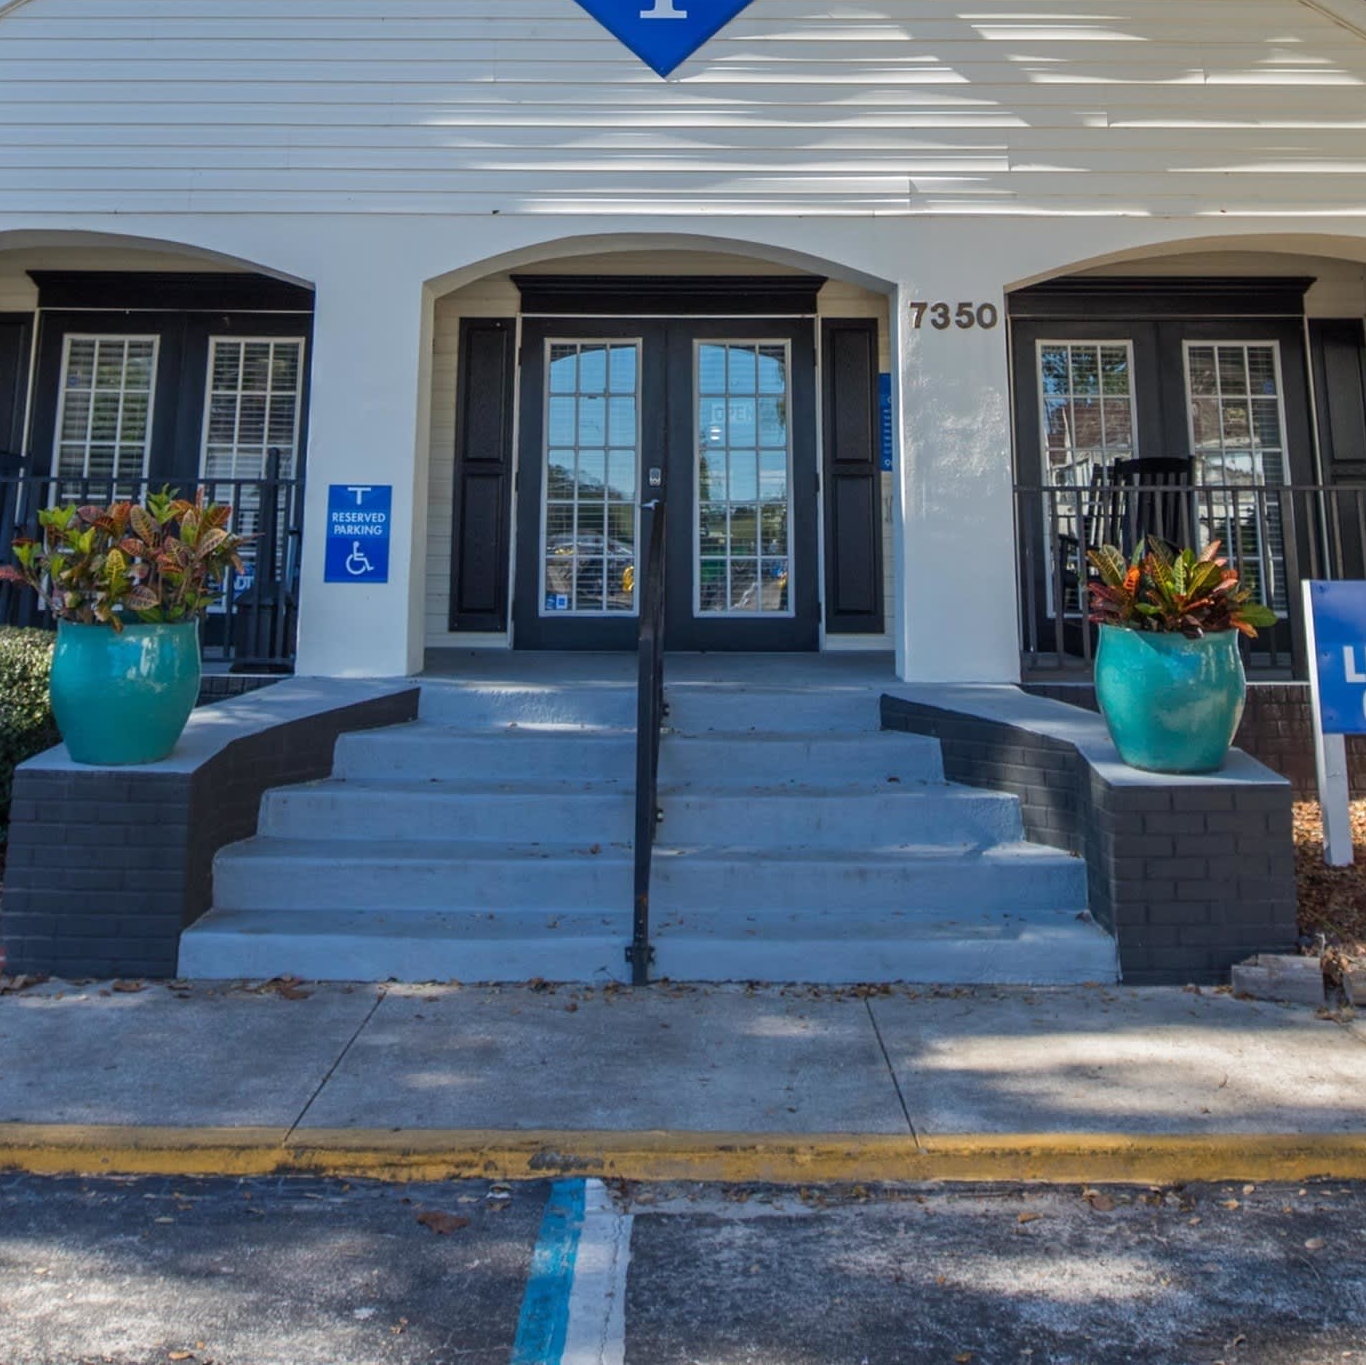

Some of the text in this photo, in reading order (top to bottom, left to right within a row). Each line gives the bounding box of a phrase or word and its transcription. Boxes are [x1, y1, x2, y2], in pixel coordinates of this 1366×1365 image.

[910, 302, 998, 329] 7350
[347, 487, 372, 505] T
[332, 512, 386, 523] RESERVED
[334, 524, 383, 535] PARKING
